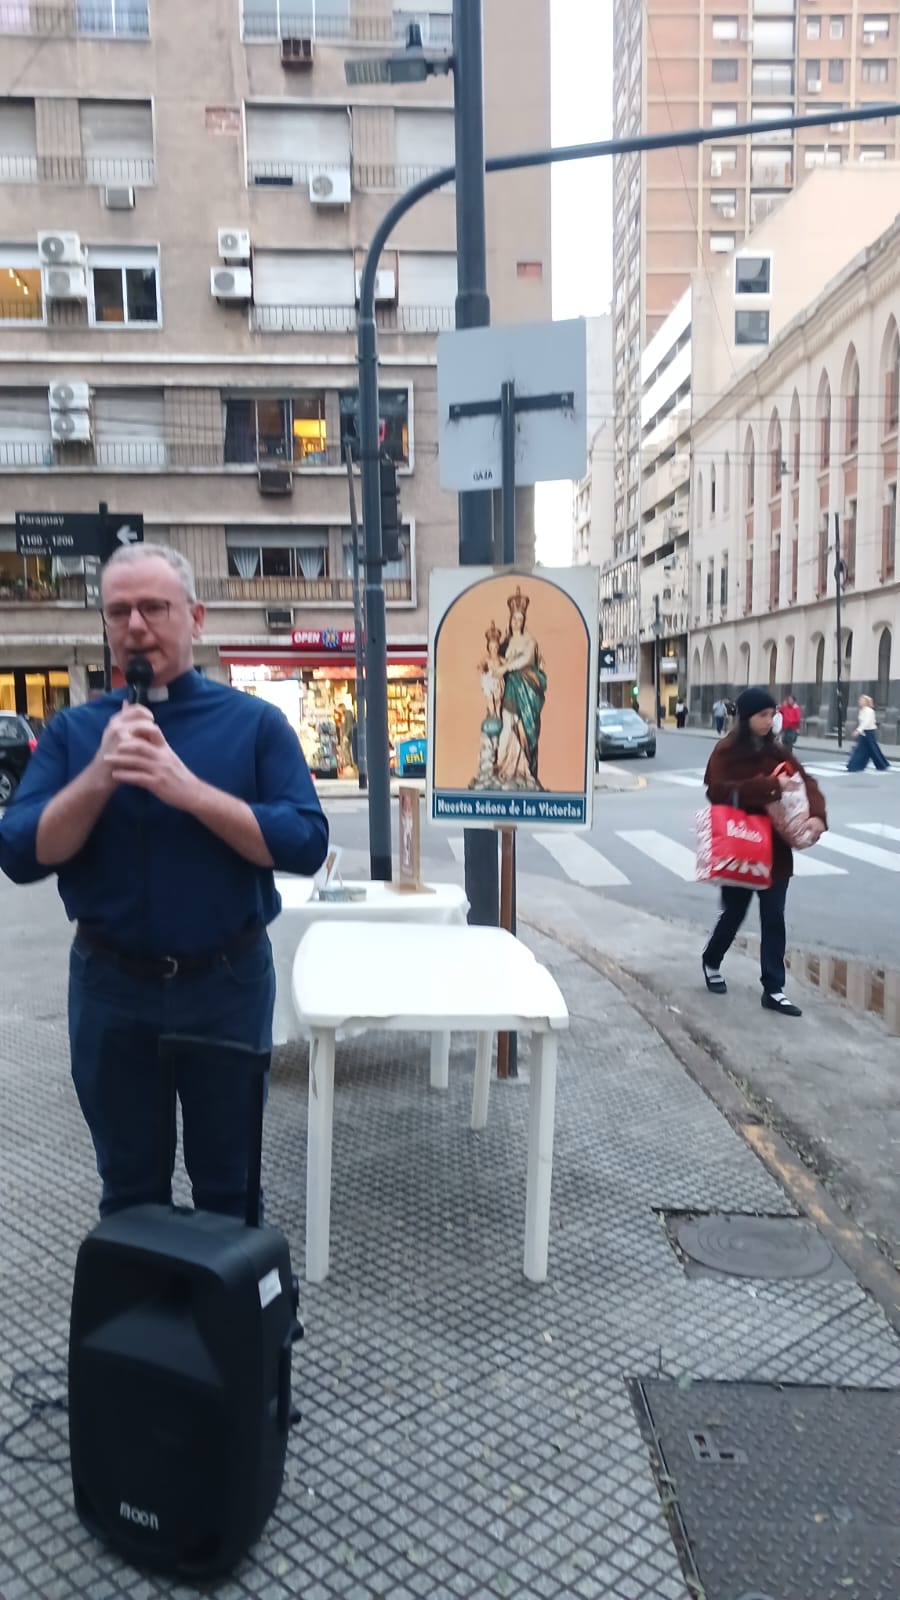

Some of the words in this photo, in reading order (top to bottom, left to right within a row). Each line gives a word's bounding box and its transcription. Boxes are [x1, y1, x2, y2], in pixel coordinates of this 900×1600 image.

[19, 514, 65, 527] Paraguay
[20, 535, 43, 546] 1100
[51, 535, 74, 547] 1200
[294, 631, 320, 644] OPEN
[437, 799, 473, 814] Nuestra
[475, 800, 507, 816] Señora
[509, 800, 520, 816] de
[523, 800, 536, 816] las
[538, 802, 582, 818] Victorias
